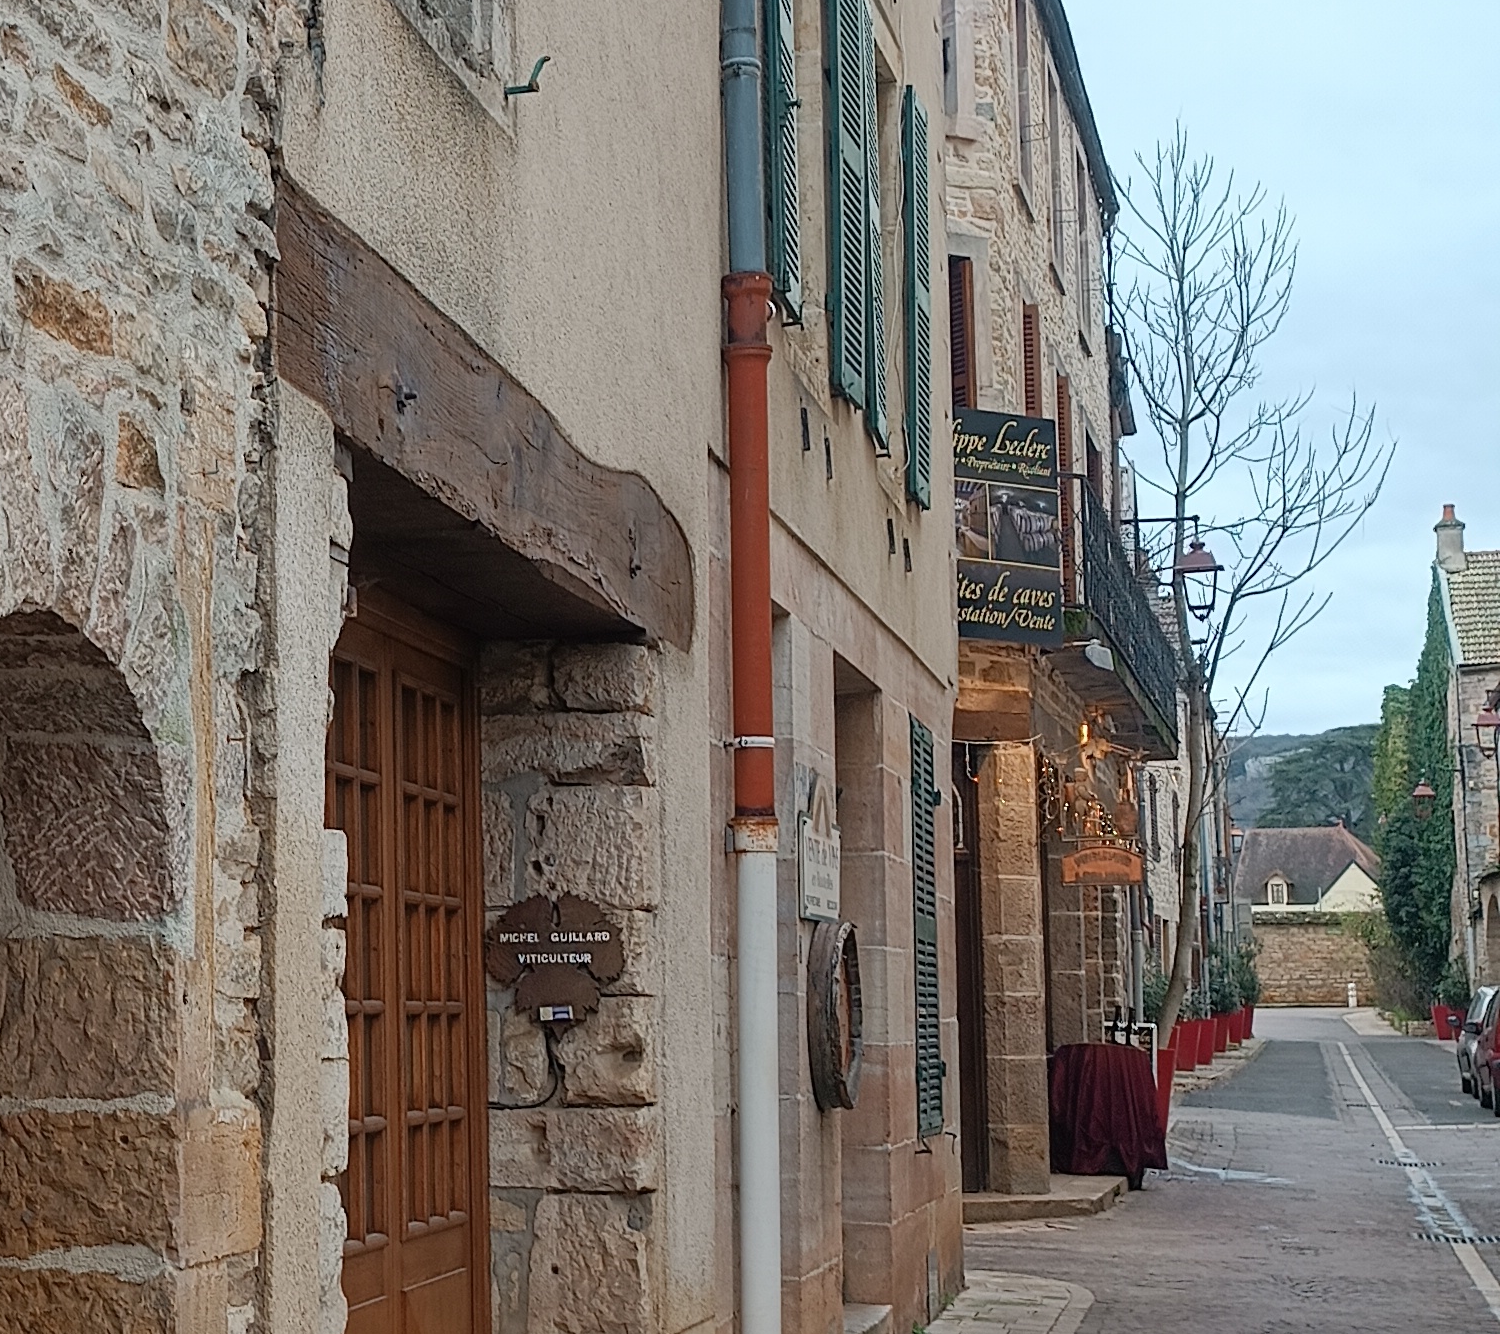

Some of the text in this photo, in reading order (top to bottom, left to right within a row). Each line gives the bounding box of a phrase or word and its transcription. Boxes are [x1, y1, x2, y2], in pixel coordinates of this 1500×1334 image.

[991, 421, 1051, 459] Leclerc
[988, 571, 1011, 602] de
[1012, 587, 1056, 608] caves
[499, 931, 610, 943] MICHEL GUILLARD
[517, 953, 592, 964] VITICULTEUR
